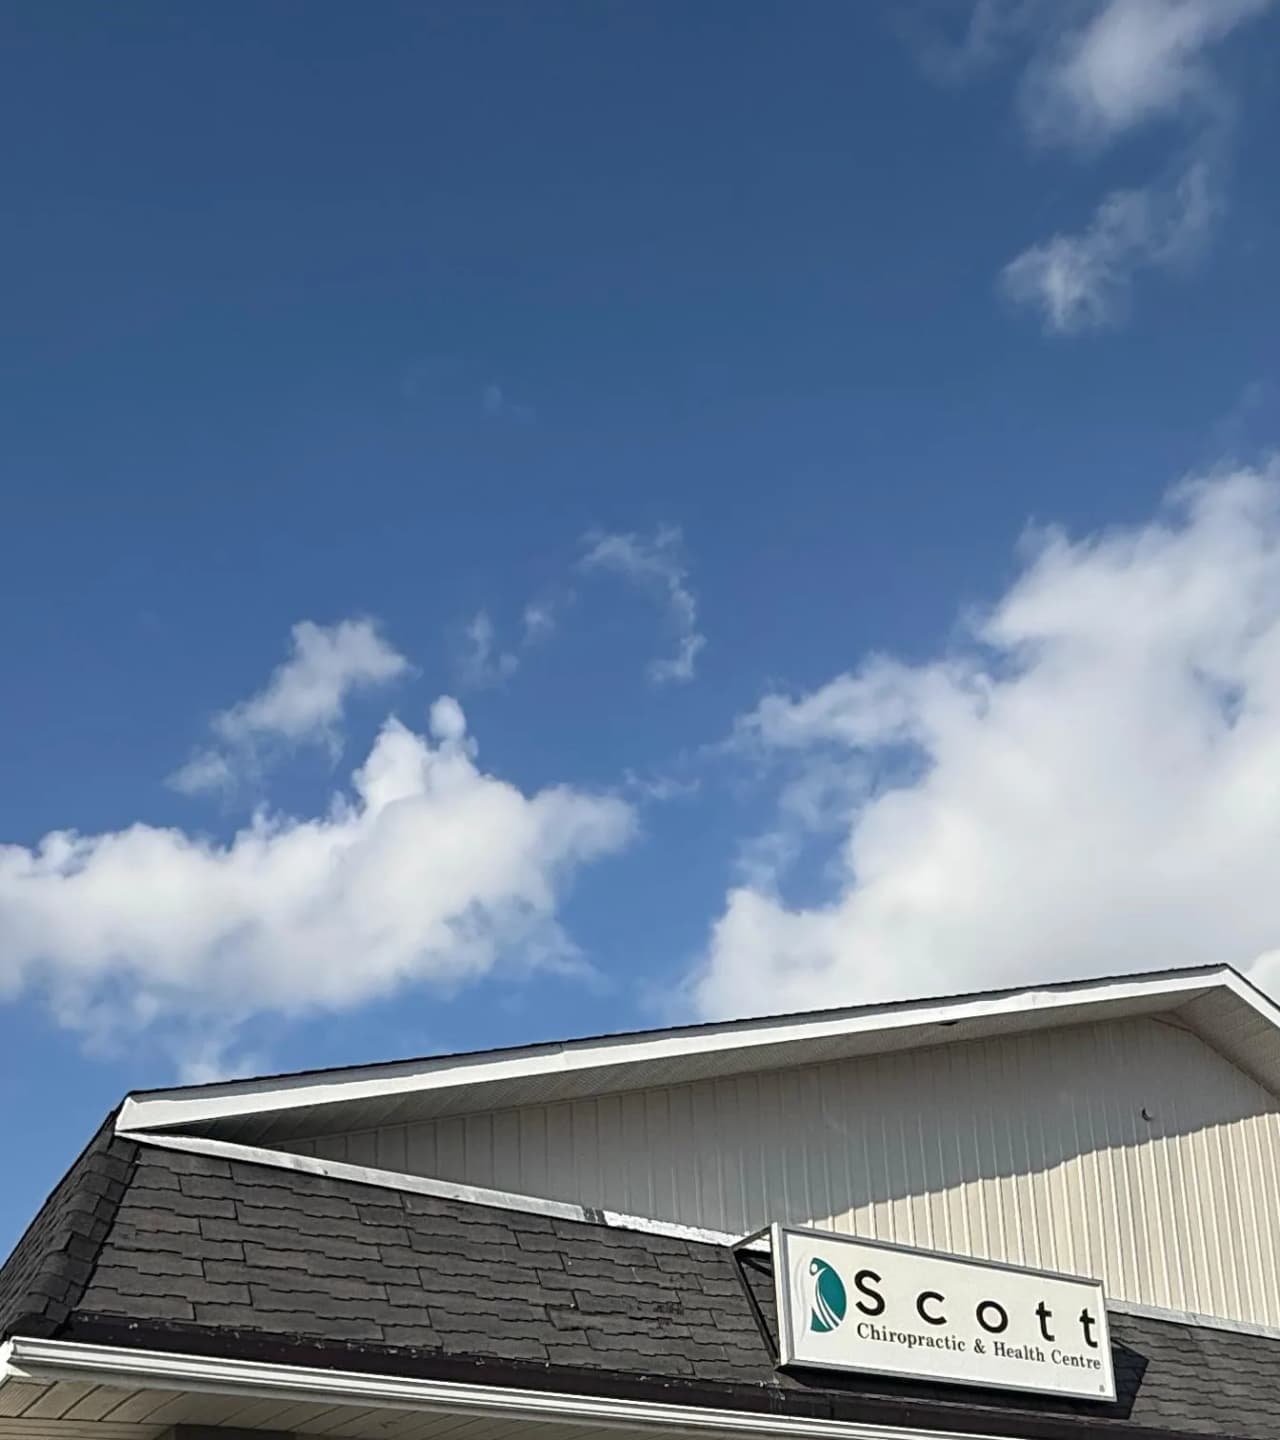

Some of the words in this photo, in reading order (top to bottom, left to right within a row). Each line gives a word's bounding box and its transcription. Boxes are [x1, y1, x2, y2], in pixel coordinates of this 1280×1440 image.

[854, 1269, 1099, 1348] Scott
[857, 1322, 966, 1352] Chiropractic
[973, 1338, 987, 1354] &
[993, 1341, 1046, 1363] Health
[1051, 1349, 1102, 1370] Centre
